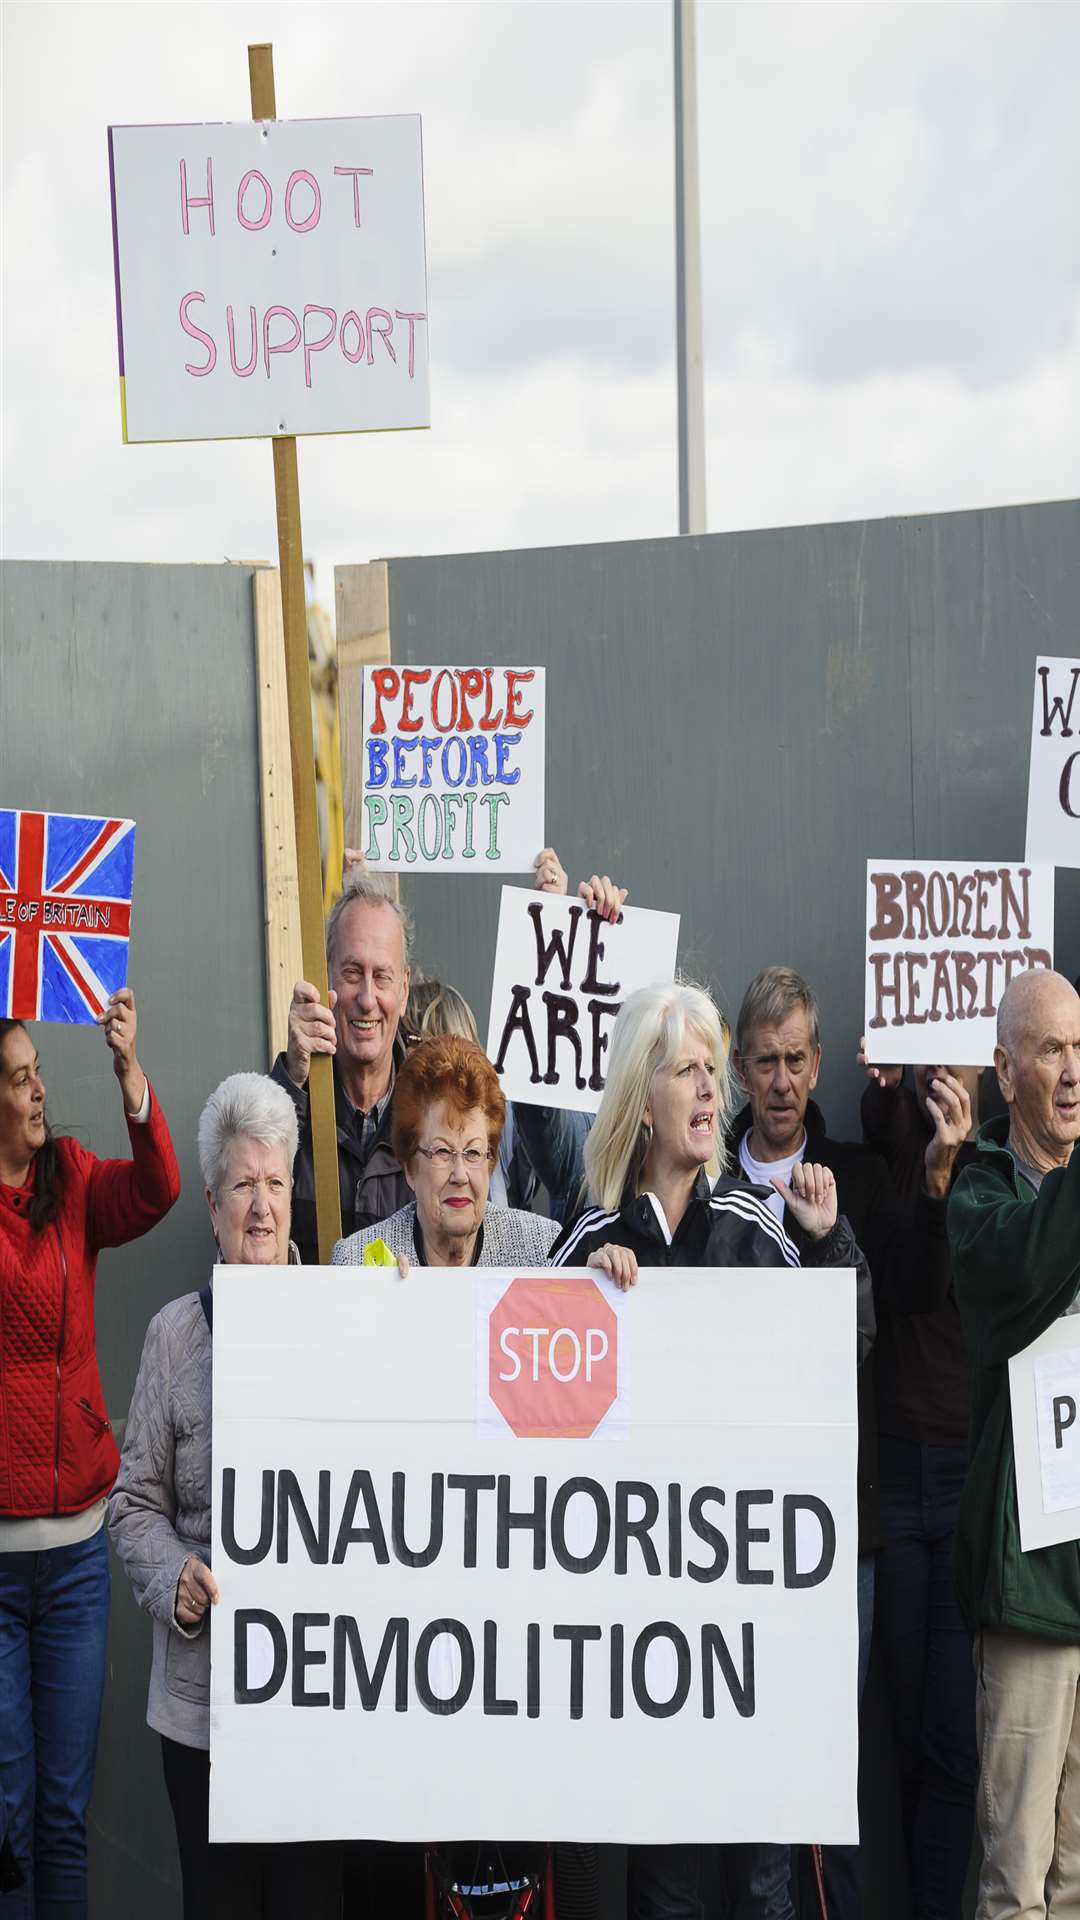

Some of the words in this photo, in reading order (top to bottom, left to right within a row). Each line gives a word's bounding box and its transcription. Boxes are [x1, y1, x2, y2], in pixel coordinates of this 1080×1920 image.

[179, 156, 374, 236] HOOT
[179, 291, 427, 388] SUPPORT
[369, 667, 535, 734] PEOPLE
[1038, 666, 1080, 738] W
[365, 732, 523, 789] BEFORE
[363, 792, 510, 863] PROFIT
[18, 901, 39, 922] OF
[43, 901, 110, 928] BRITAIN
[868, 867, 1032, 941] BROKEN
[527, 901, 624, 996] WE
[499, 1327, 609, 1382] STOP
[220, 1467, 837, 1589] UNAUTHORISED
[233, 1608, 755, 1720] DEMOLITION
